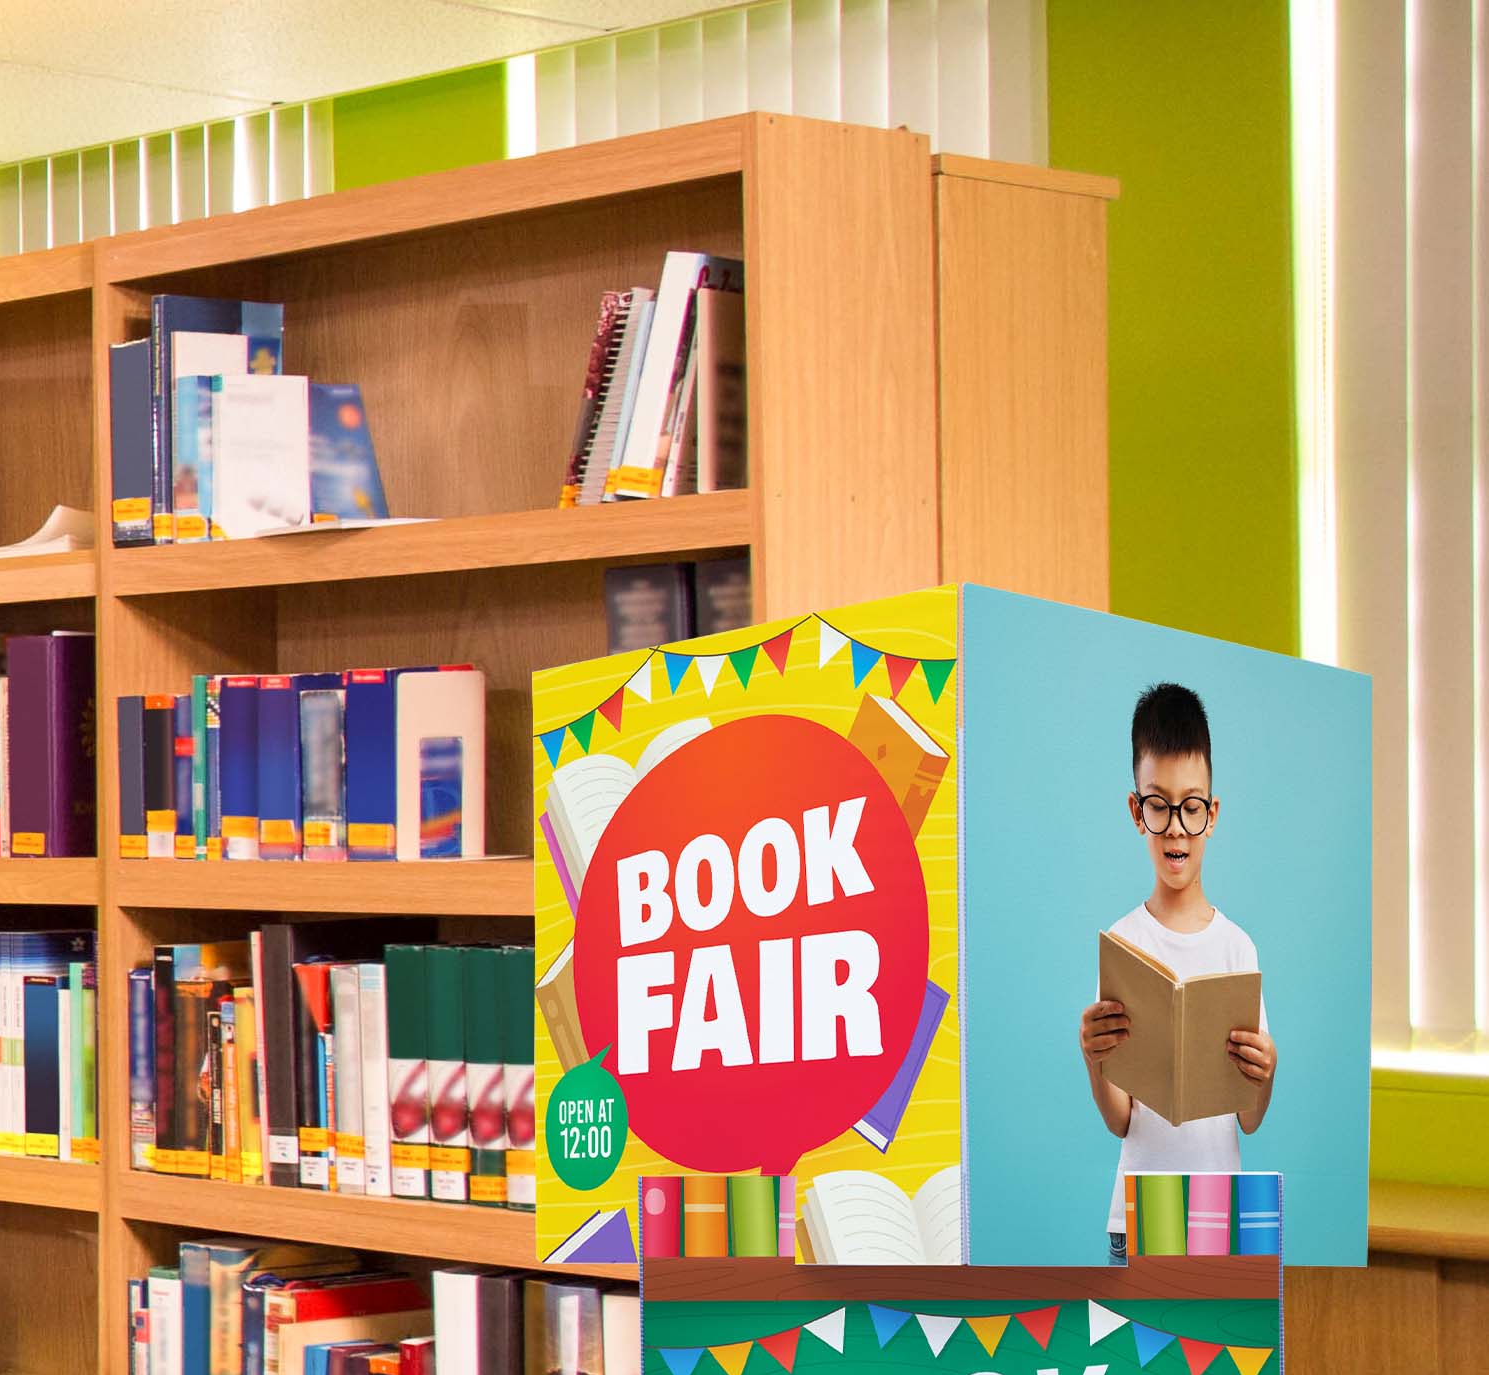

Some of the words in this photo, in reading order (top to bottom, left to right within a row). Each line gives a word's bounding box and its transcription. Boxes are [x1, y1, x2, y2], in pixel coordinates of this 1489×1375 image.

[616, 796, 876, 948] BOOK
[616, 930, 883, 1076] FAIR
[559, 1099, 594, 1125] OPEN
[598, 1098, 615, 1123] AT
[560, 1125, 612, 1159] 12:00
